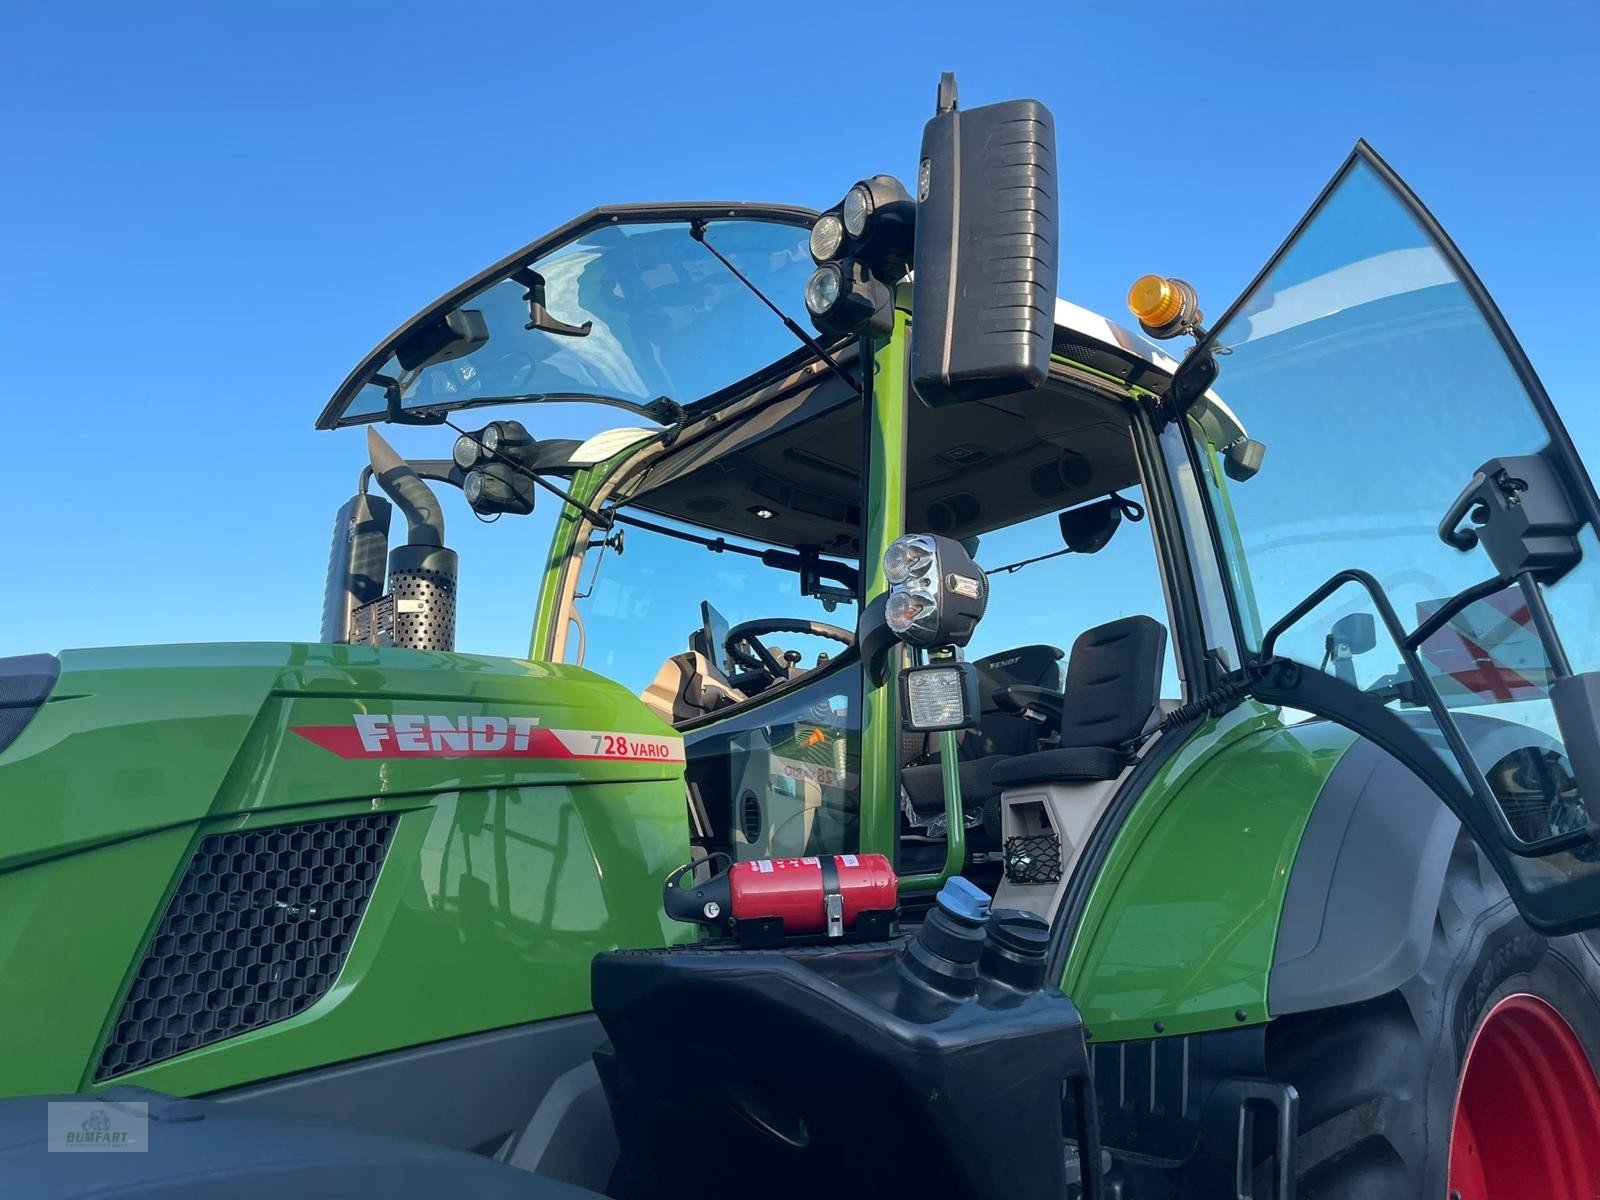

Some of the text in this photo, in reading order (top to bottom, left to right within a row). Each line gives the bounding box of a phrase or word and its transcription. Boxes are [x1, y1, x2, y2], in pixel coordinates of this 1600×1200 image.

[990, 656, 1021, 669] FENDT
[353, 714, 540, 752] FENDT
[591, 735, 670, 758] 728 VARIO
